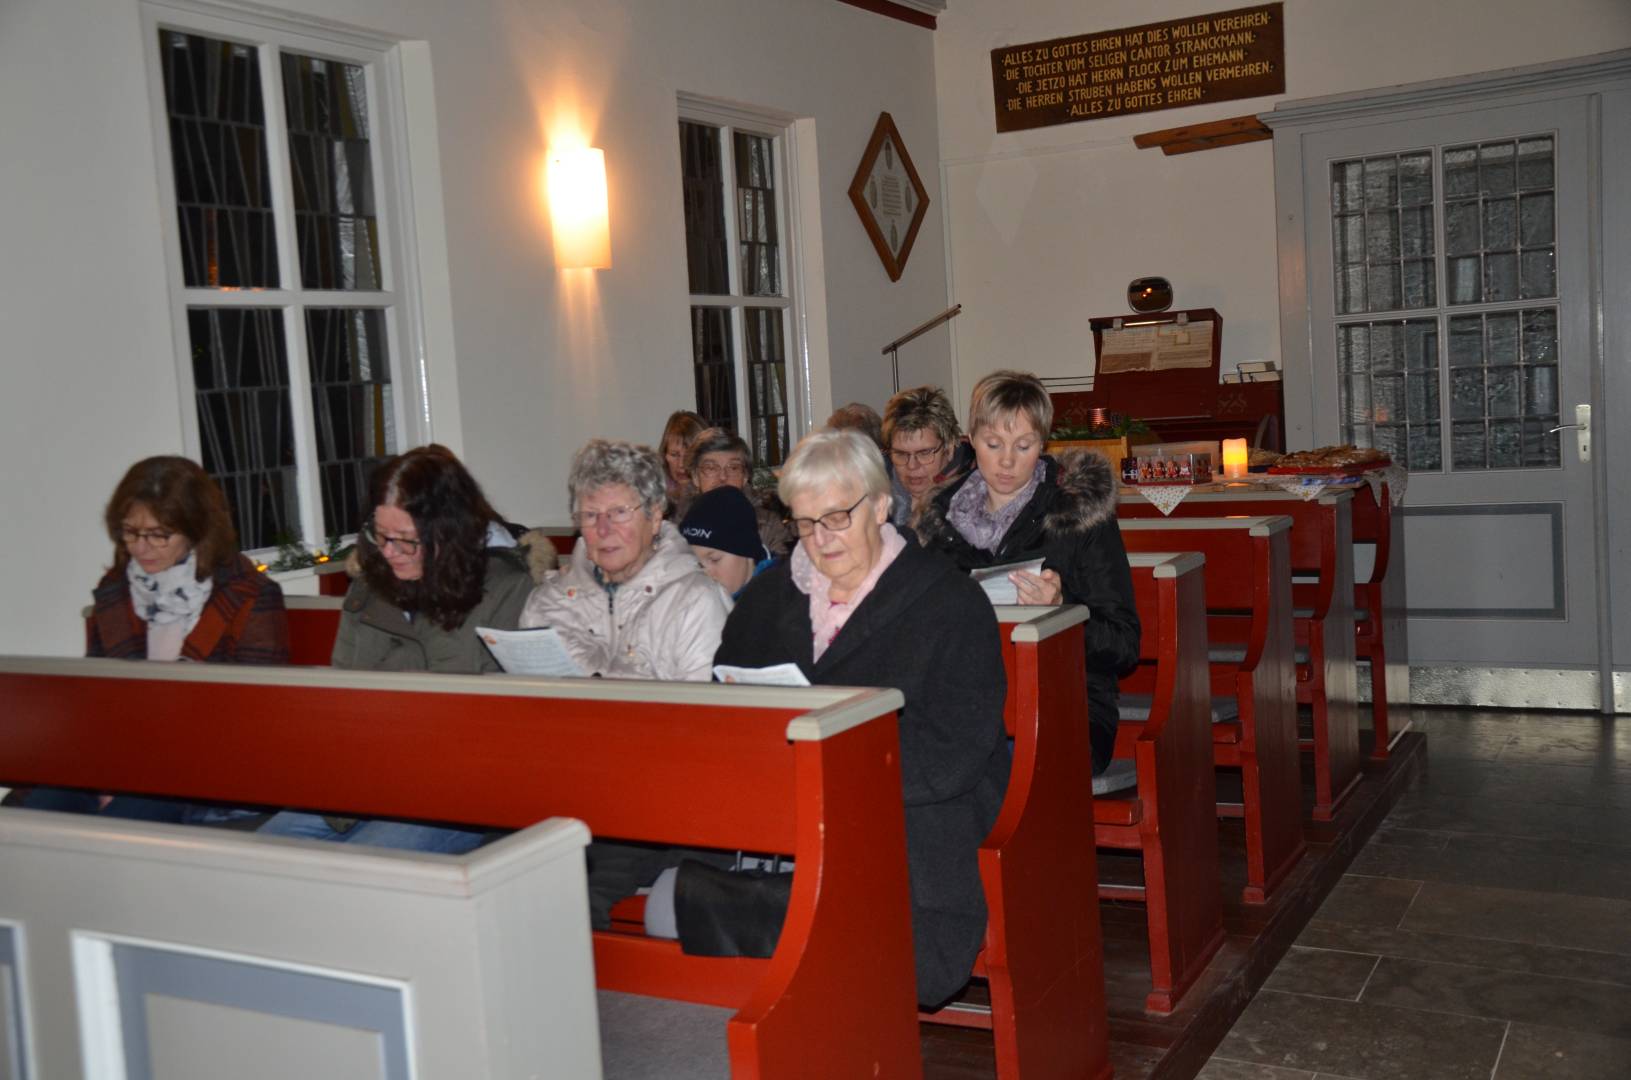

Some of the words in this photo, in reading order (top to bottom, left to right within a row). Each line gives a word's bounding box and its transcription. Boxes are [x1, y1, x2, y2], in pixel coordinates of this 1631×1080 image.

[1004, 51, 1033, 66] ALLES
[1036, 48, 1049, 61] ZU
[1052, 41, 1088, 57] GOTTES
[1091, 36, 1121, 52] EHREN
[1125, 32, 1144, 46] HAT
[1147, 28, 1168, 43] DIES
[1172, 22, 1209, 38] WOLLEN
[1006, 67, 1019, 80] DIE
[1023, 61, 1063, 78] TOCHTER
[1065, 58, 1085, 71] VOM
[1089, 51, 1127, 68] SELIGEN
[1131, 45, 1171, 62] CANTOR
[1008, 97, 1022, 111] DIE
[1026, 92, 1063, 109] HERREN
[1068, 84, 1112, 102] STRUBEN
[1116, 78, 1156, 94] HABENS
[1161, 72, 1201, 88] WOLLEN
[1018, 81, 1032, 94] DIE
[1037, 76, 1065, 91] JETZO
[1068, 72, 1088, 87] HAT
[1092, 67, 1124, 83] HERRN
[1129, 63, 1161, 78] FLOCK
[1164, 57, 1188, 72] ZUM
[1070, 100, 1103, 117] ALLES
[1107, 98, 1121, 112] ZU
[1125, 92, 1163, 108] GOTTES
